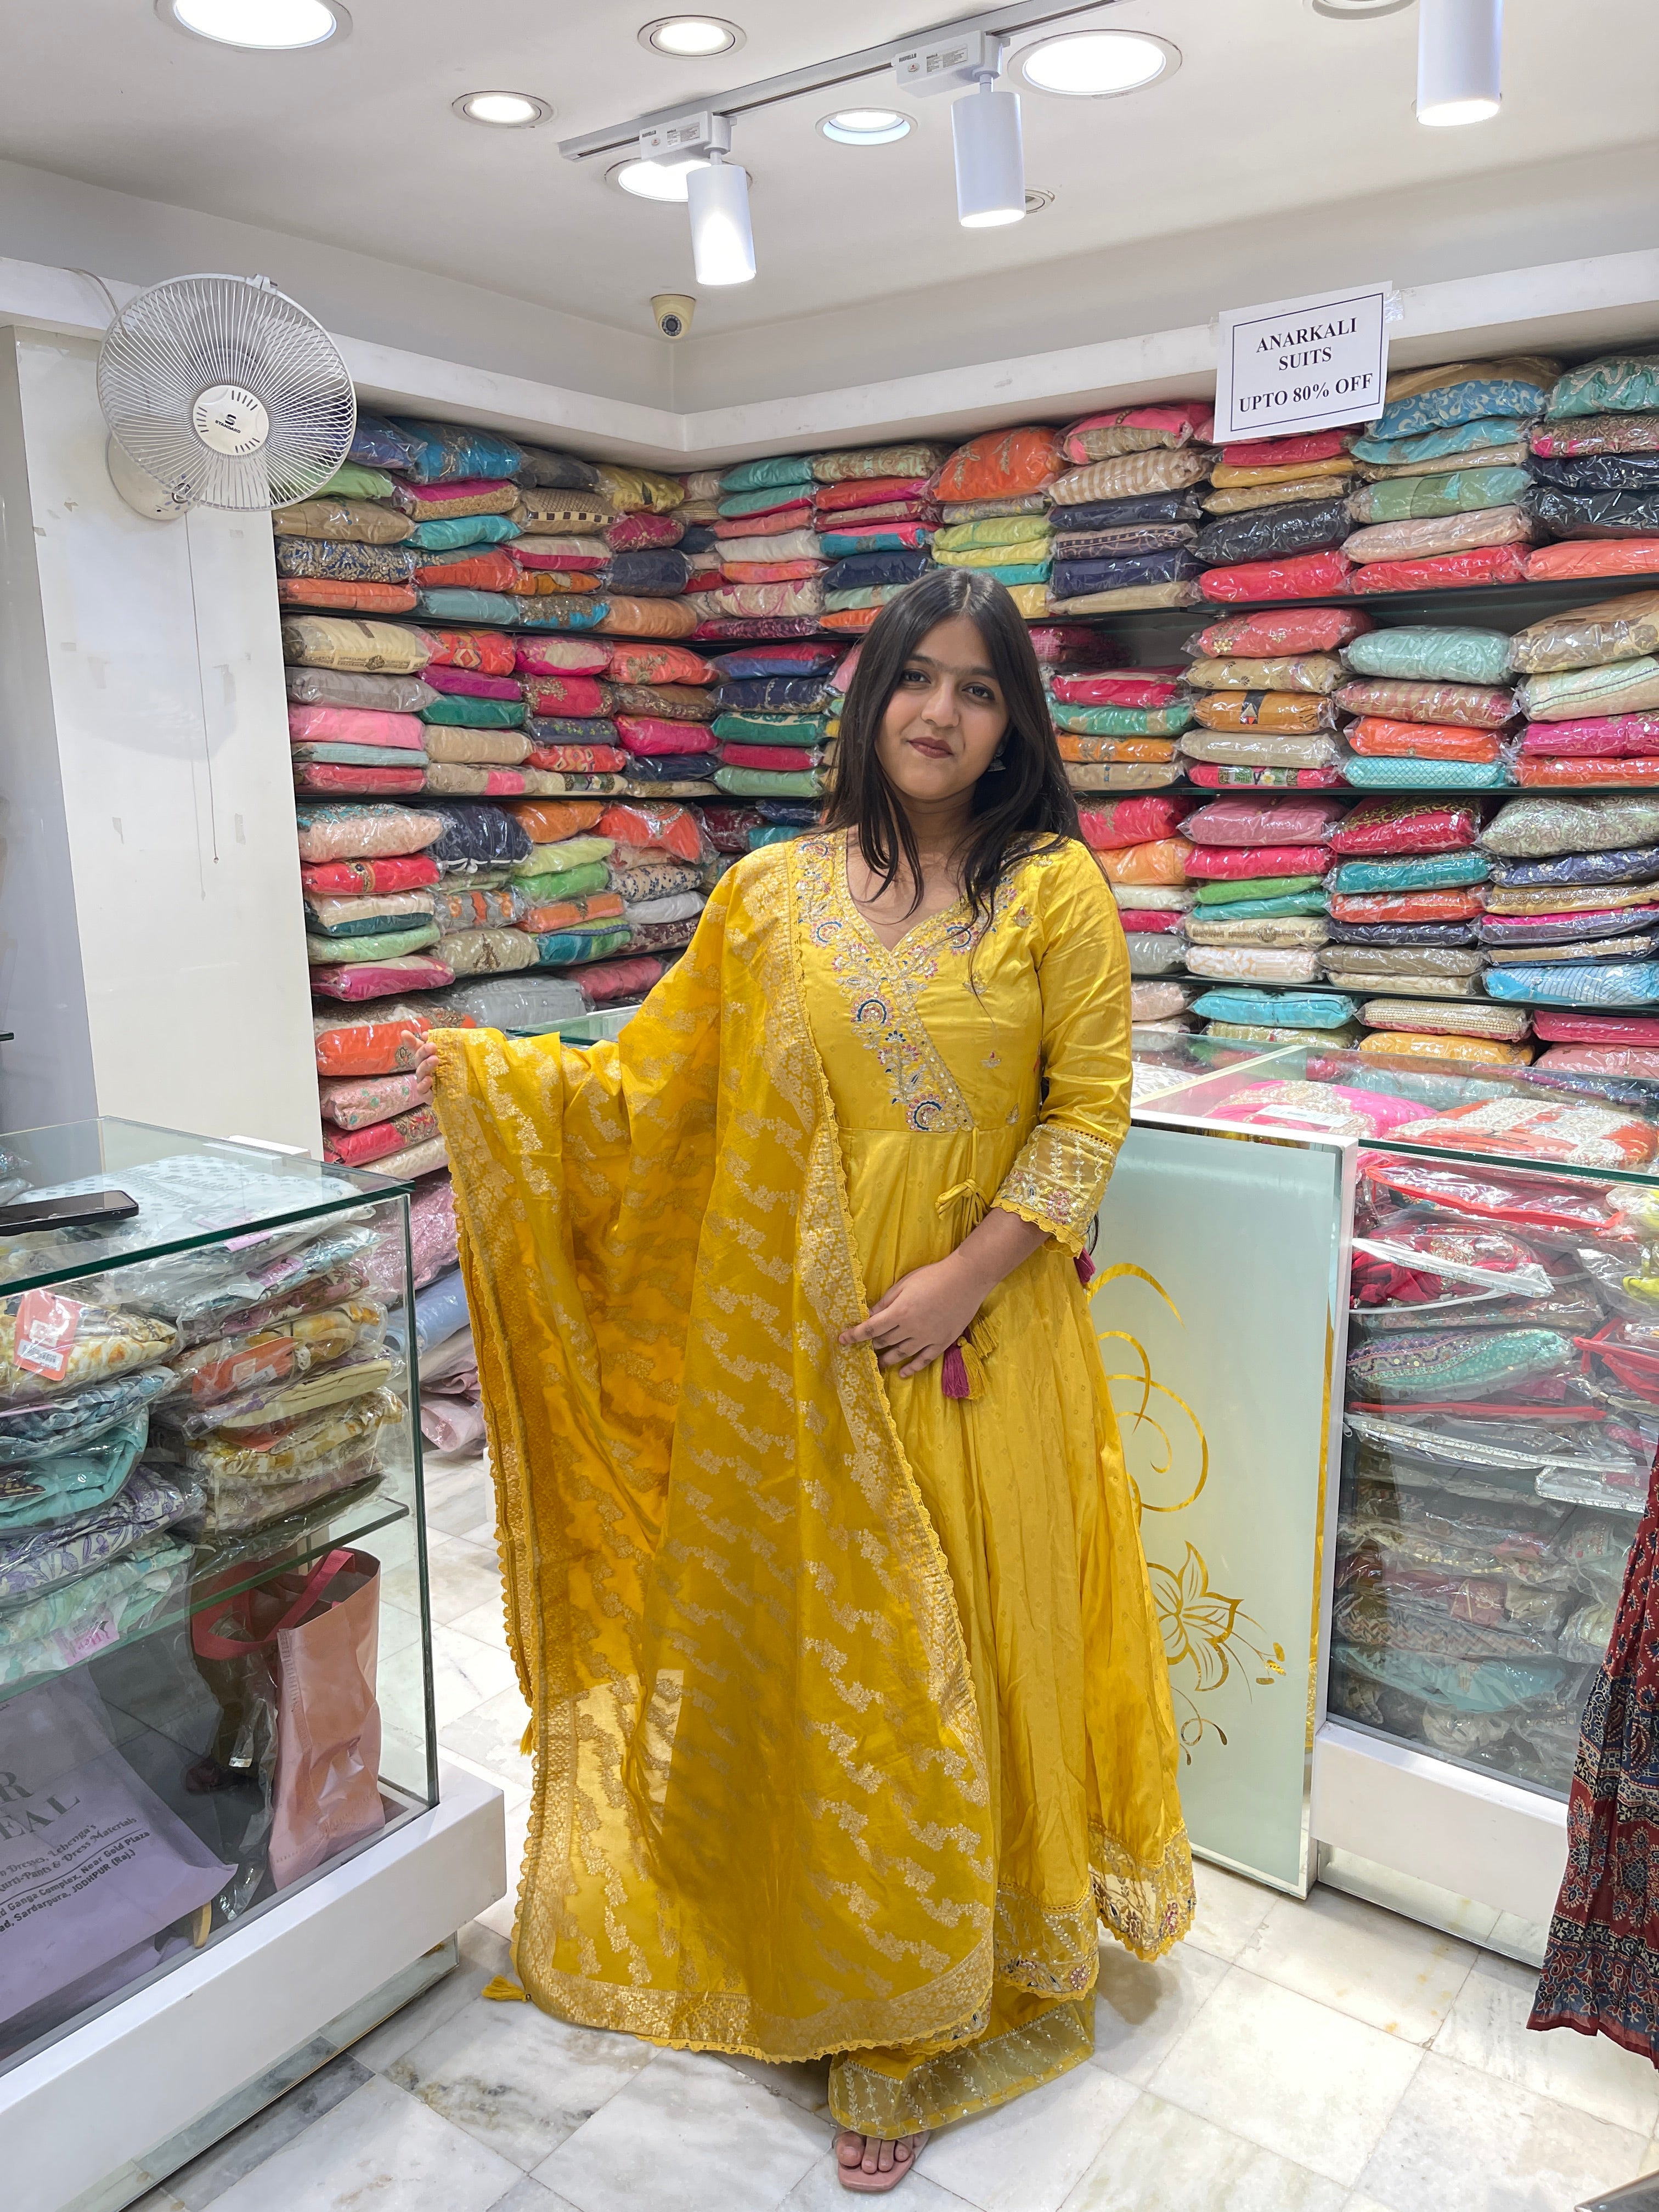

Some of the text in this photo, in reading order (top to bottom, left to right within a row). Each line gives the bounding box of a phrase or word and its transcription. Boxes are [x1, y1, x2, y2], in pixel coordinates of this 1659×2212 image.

[1256, 317, 1357, 353] ANARKALI
[1278, 347, 1332, 371] SUITS
[1239, 373, 1373, 413] UPTO 80% OFF
[215, 420, 241, 433] STANDARD
[6, 1857, 49, 1872] Dresses,
[47, 1824, 97, 1857] Lehenga's
[52, 1860, 61, 1869] &
[61, 1841, 91, 1861] Dress
[89, 1818, 137, 1843] Materials
[8, 1893, 38, 1911] Ganga
[81, 1856, 103, 1874] Near
[103, 1842, 126, 1858] Gold
[124, 1831, 150, 1846] Plaza
[14, 1892, 72, 1922] Sardarpura,
[72, 1863, 111, 1893] JODHPUR
[111, 1848, 136, 1866] (Raj.)
